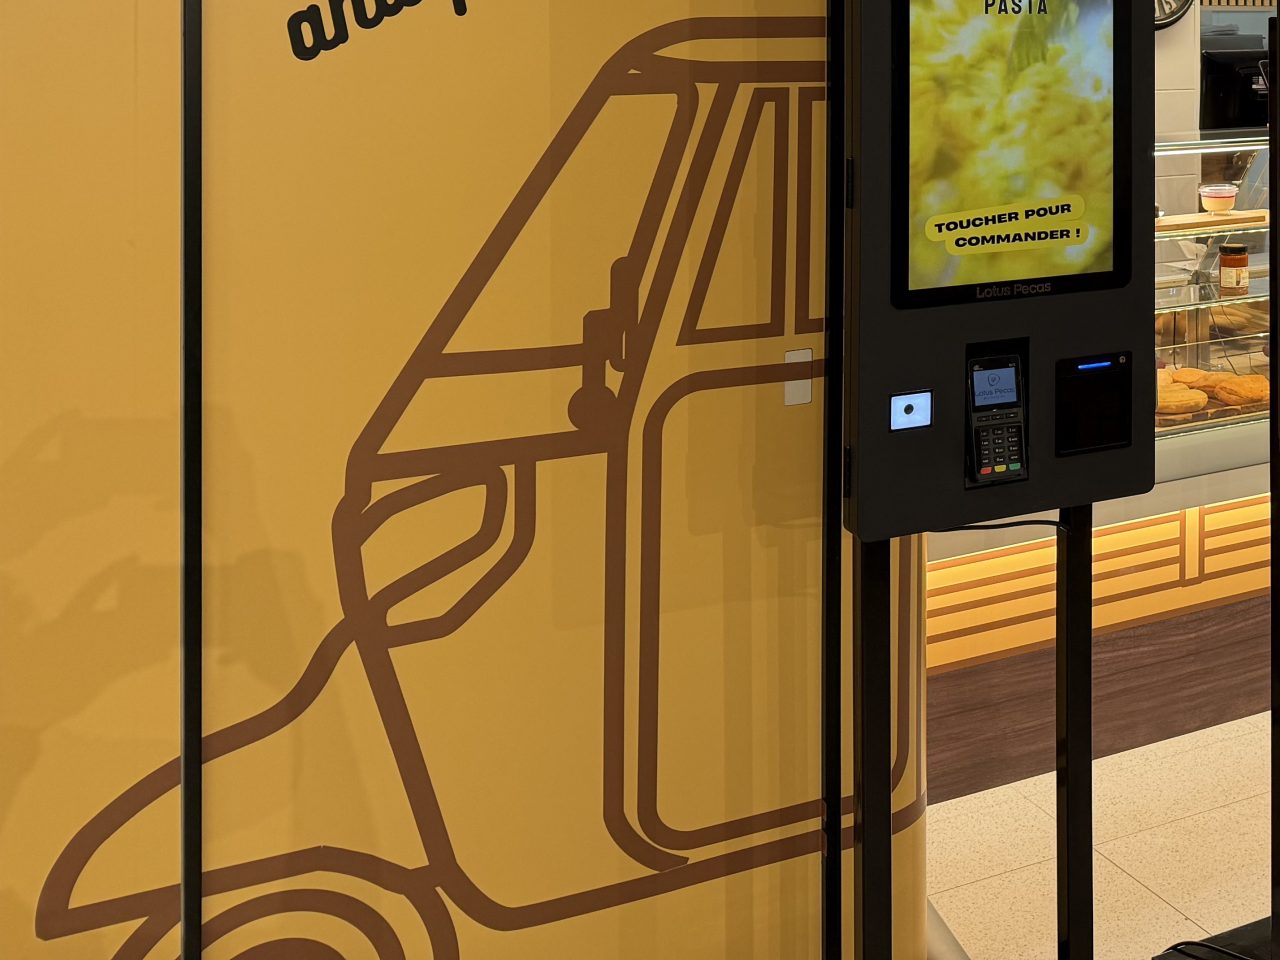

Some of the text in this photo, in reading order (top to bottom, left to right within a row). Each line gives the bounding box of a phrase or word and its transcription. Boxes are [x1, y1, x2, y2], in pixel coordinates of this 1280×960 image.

[934, 203, 1072, 233] TOUCHER POUR
[954, 229, 1070, 248] COMMANDER
[976, 282, 1053, 299] Lotus Pecas
